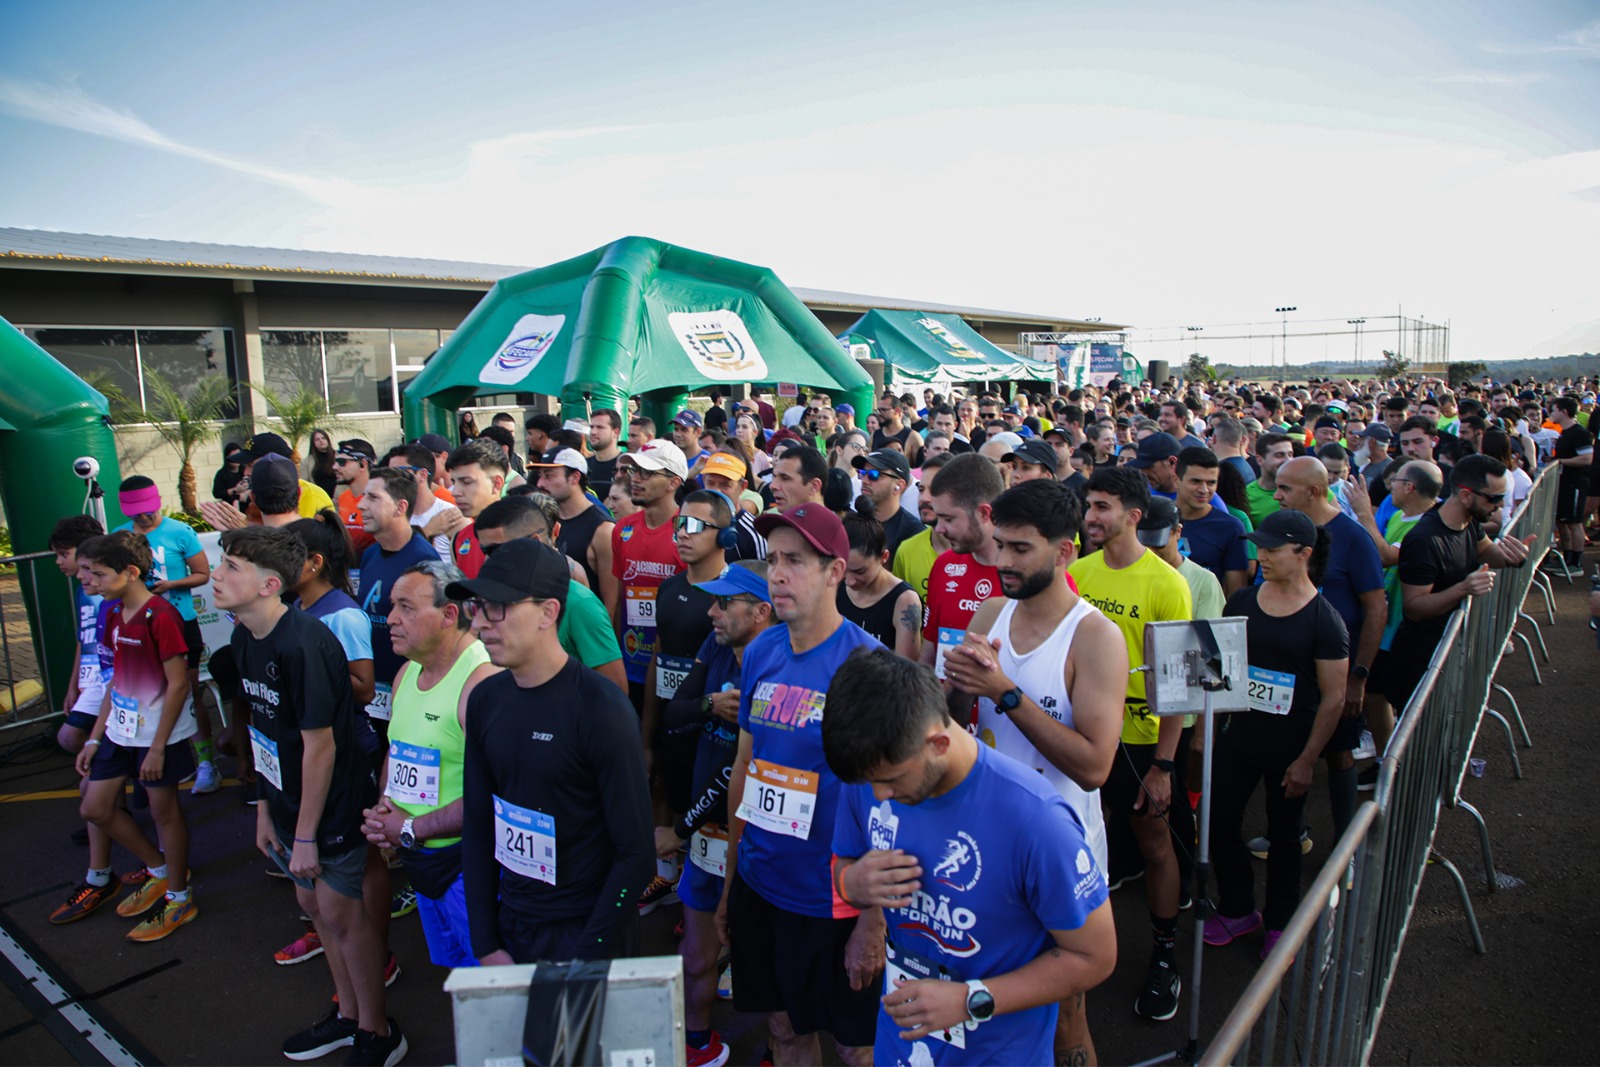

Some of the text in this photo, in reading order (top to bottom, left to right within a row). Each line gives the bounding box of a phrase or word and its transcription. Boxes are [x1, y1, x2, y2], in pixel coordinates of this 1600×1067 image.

[639, 602, 653, 616] 59
[1129, 604, 1140, 619] &
[663, 671, 684, 689] 586
[1248, 681, 1274, 701] 221
[394, 763, 418, 788] 306
[758, 786, 786, 815] 161
[871, 816, 894, 842] Bom
[506, 827, 535, 859] 241
[900, 908, 964, 942] FOR FUN
[903, 956, 931, 976] INTEGRADO
